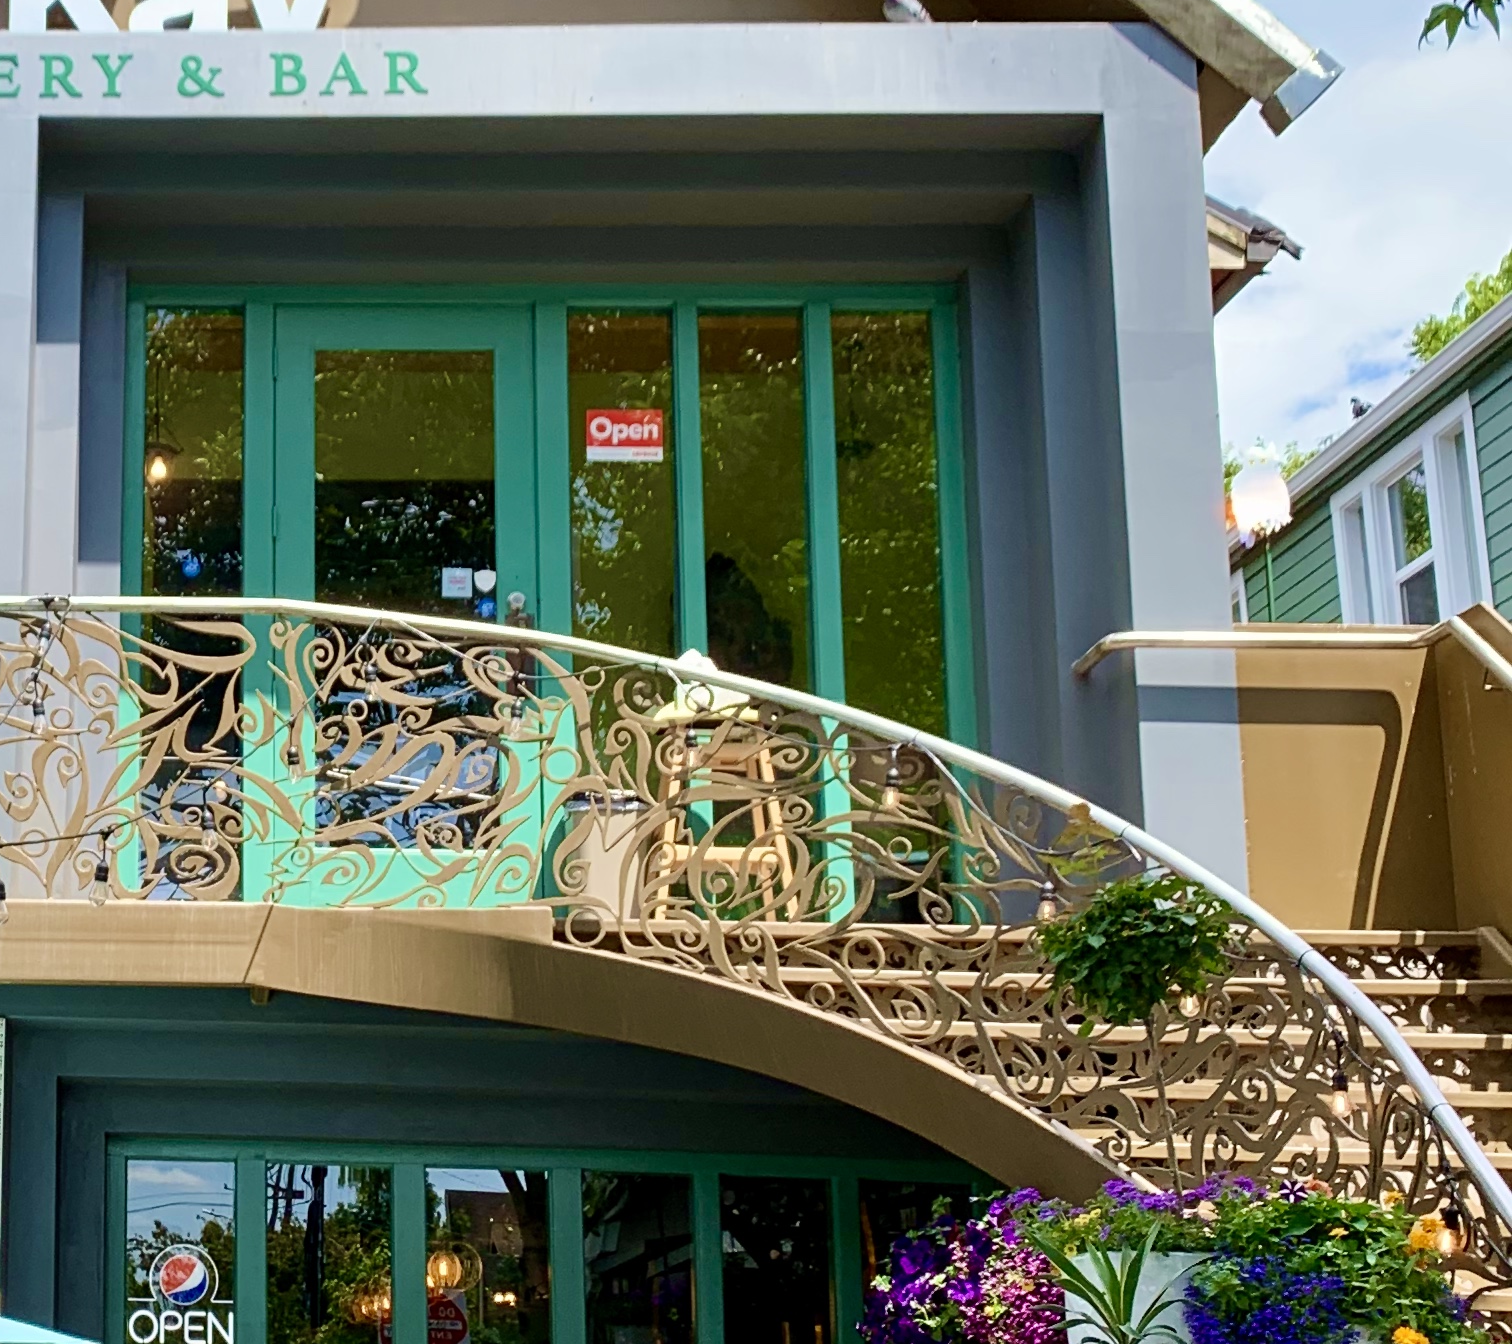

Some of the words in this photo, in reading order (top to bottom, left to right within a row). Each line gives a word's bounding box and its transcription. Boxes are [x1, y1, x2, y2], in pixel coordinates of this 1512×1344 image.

[178, 55, 224, 99] &
[270, 50, 429, 98] BAR
[590, 416, 659, 445] Open
